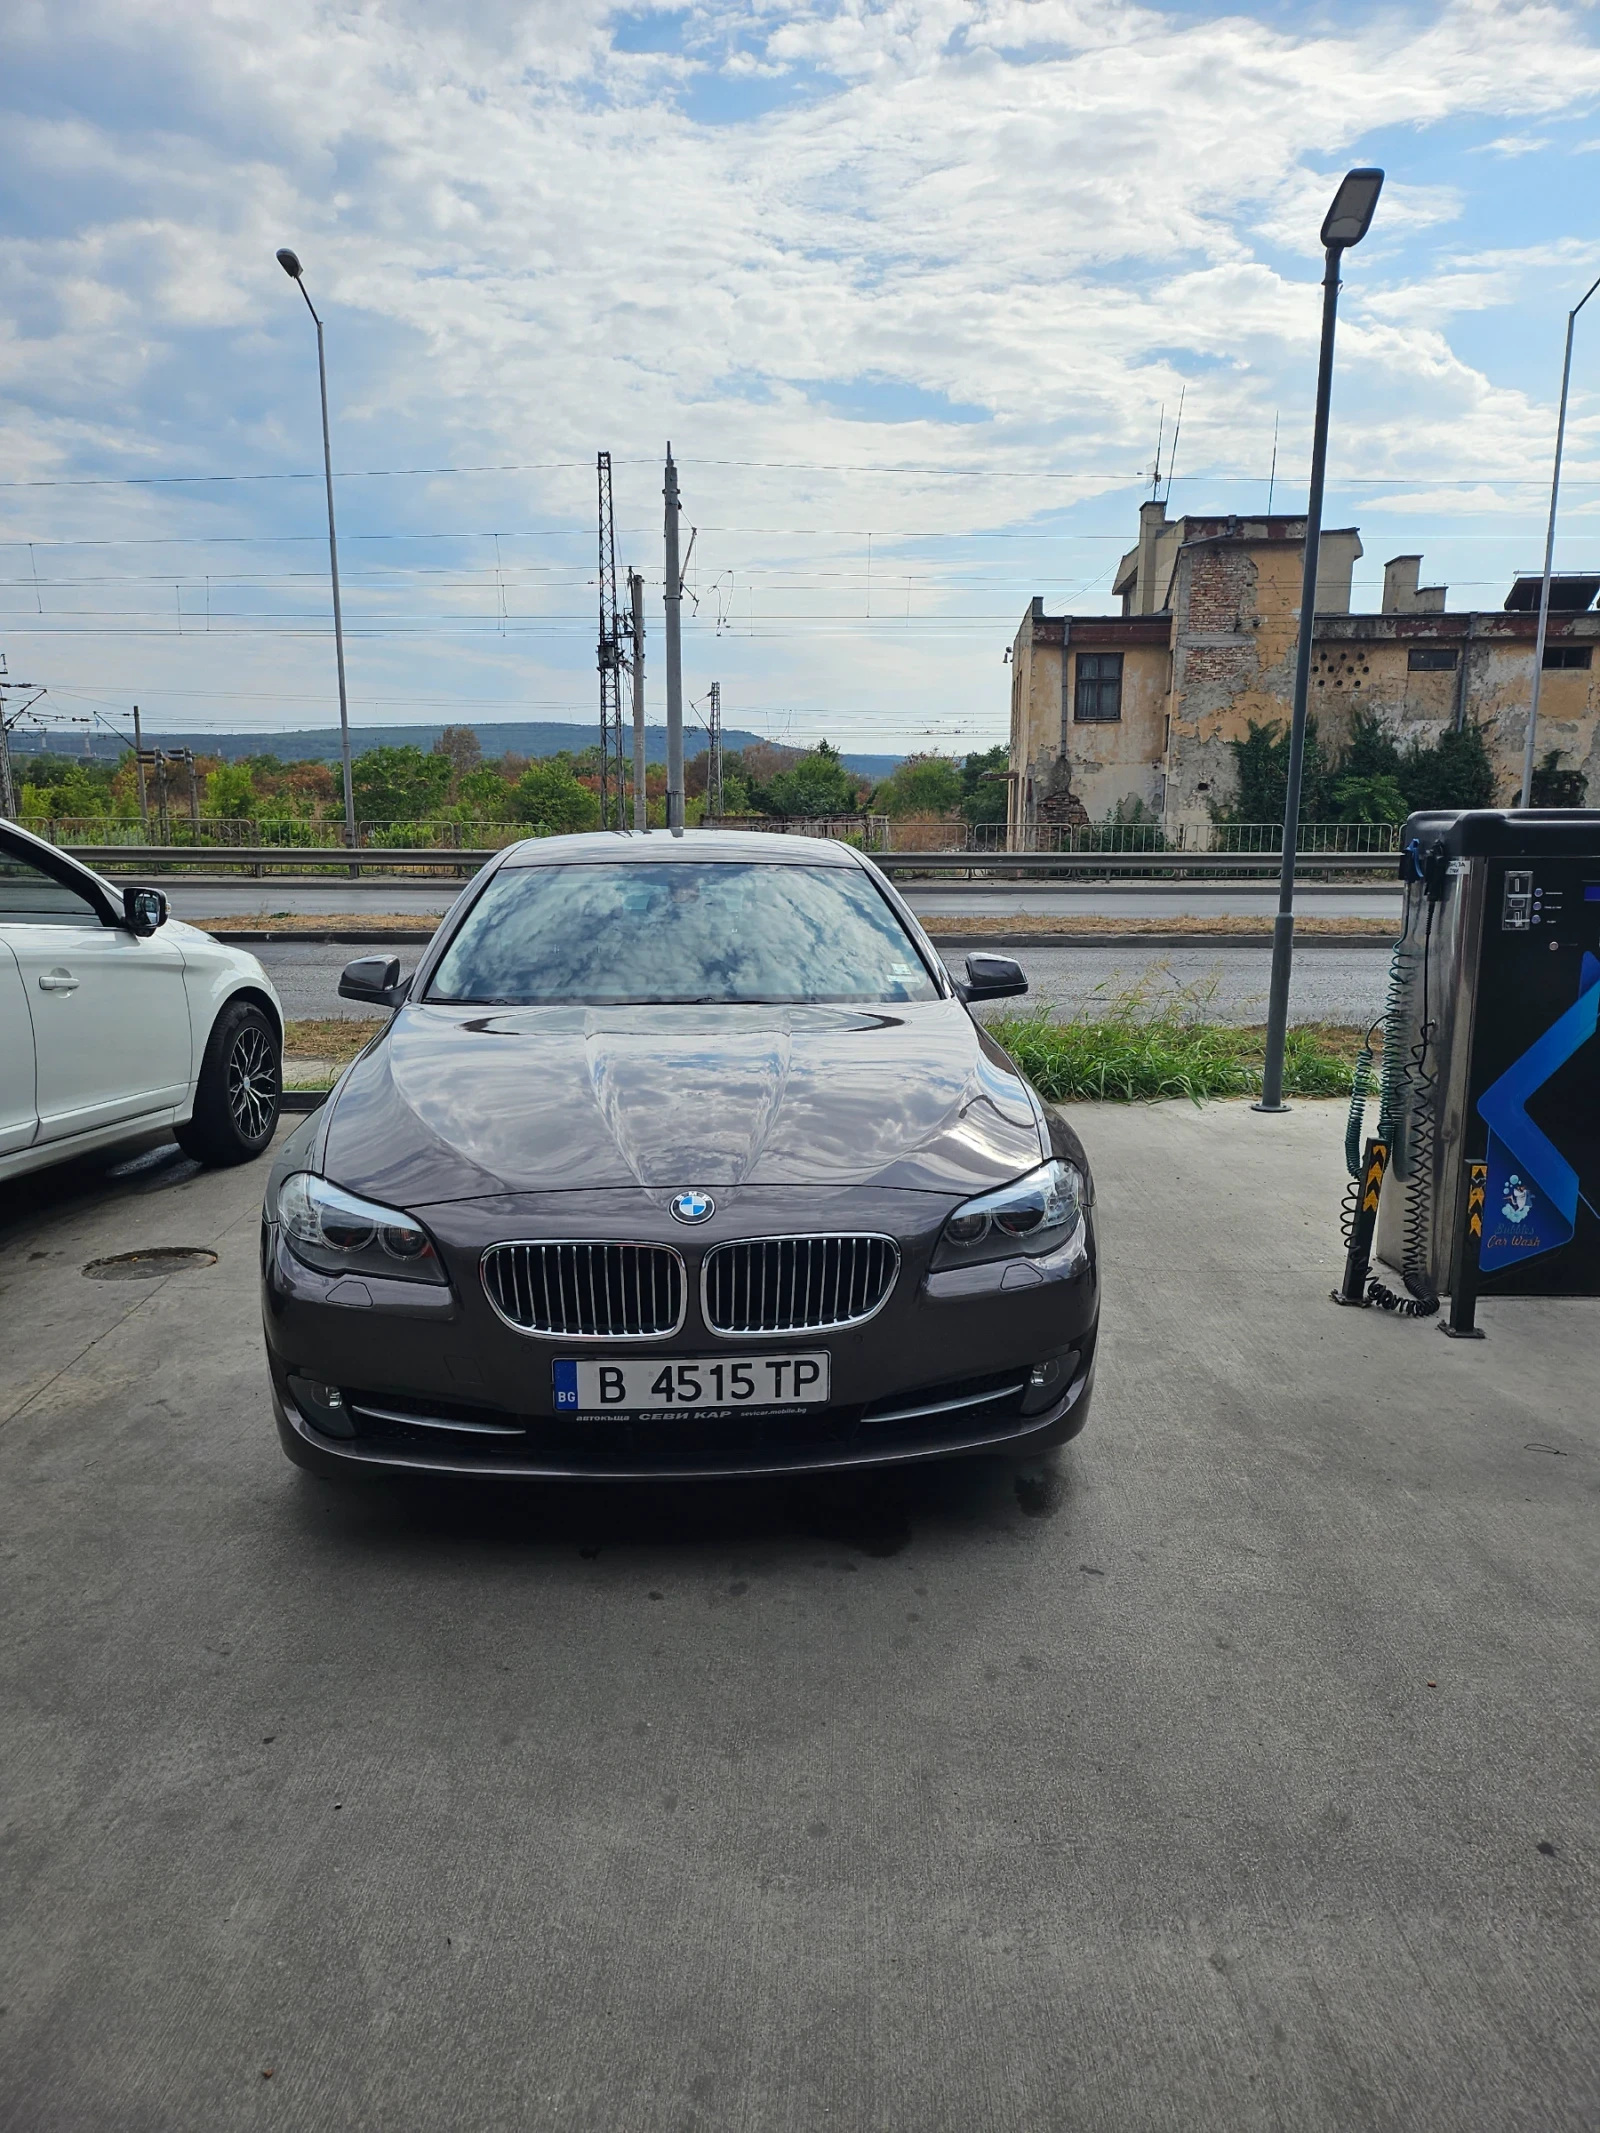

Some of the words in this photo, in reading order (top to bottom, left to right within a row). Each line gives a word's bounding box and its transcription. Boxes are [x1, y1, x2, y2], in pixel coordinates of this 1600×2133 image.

[675, 1191, 711, 1201] BMW
[1495, 1223, 1535, 1235] Bubbles
[1487, 1235, 1507, 1248] Car
[1511, 1236, 1540, 1247] Wash
[599, 1367, 627, 1404] B
[651, 1363, 755, 1403] 4515
[766, 1360, 820, 1398] TP
[558, 1391, 576, 1403] BG
[576, 1414, 630, 1422] автокъща
[638, 1412, 689, 1421] СЕВИ
[694, 1410, 732, 1419] КАР
